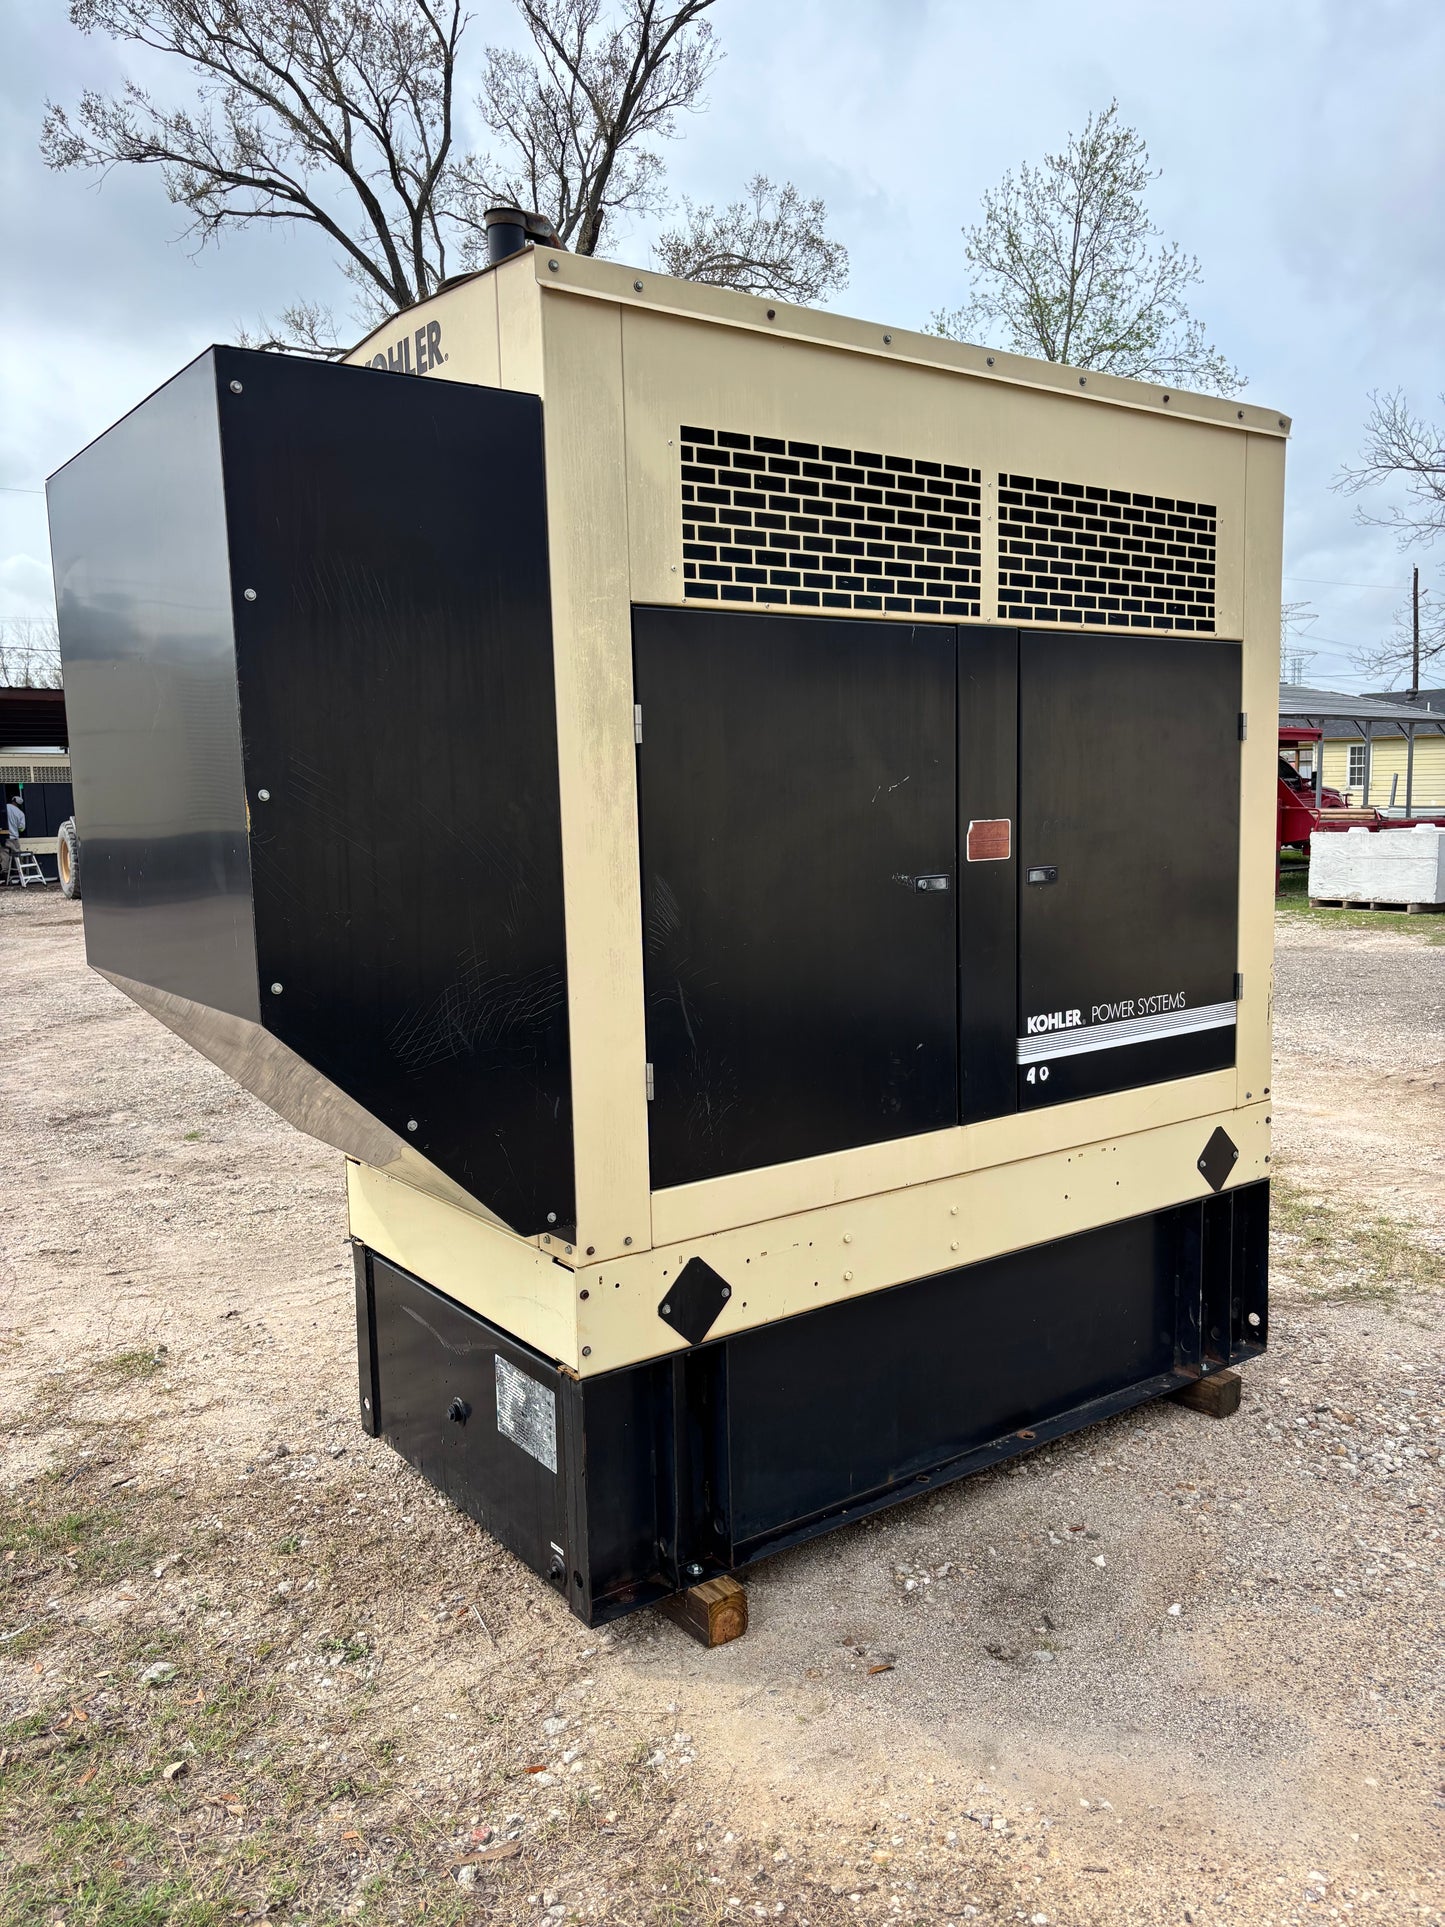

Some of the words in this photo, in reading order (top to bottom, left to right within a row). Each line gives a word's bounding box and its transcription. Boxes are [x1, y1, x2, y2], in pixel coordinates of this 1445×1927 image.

[365, 320, 444, 375] HLER
[1027, 1009, 1082, 1034] KOHLER
[1091, 1000, 1135, 1023] POWER
[1137, 991, 1186, 1015] SYSTEMS
